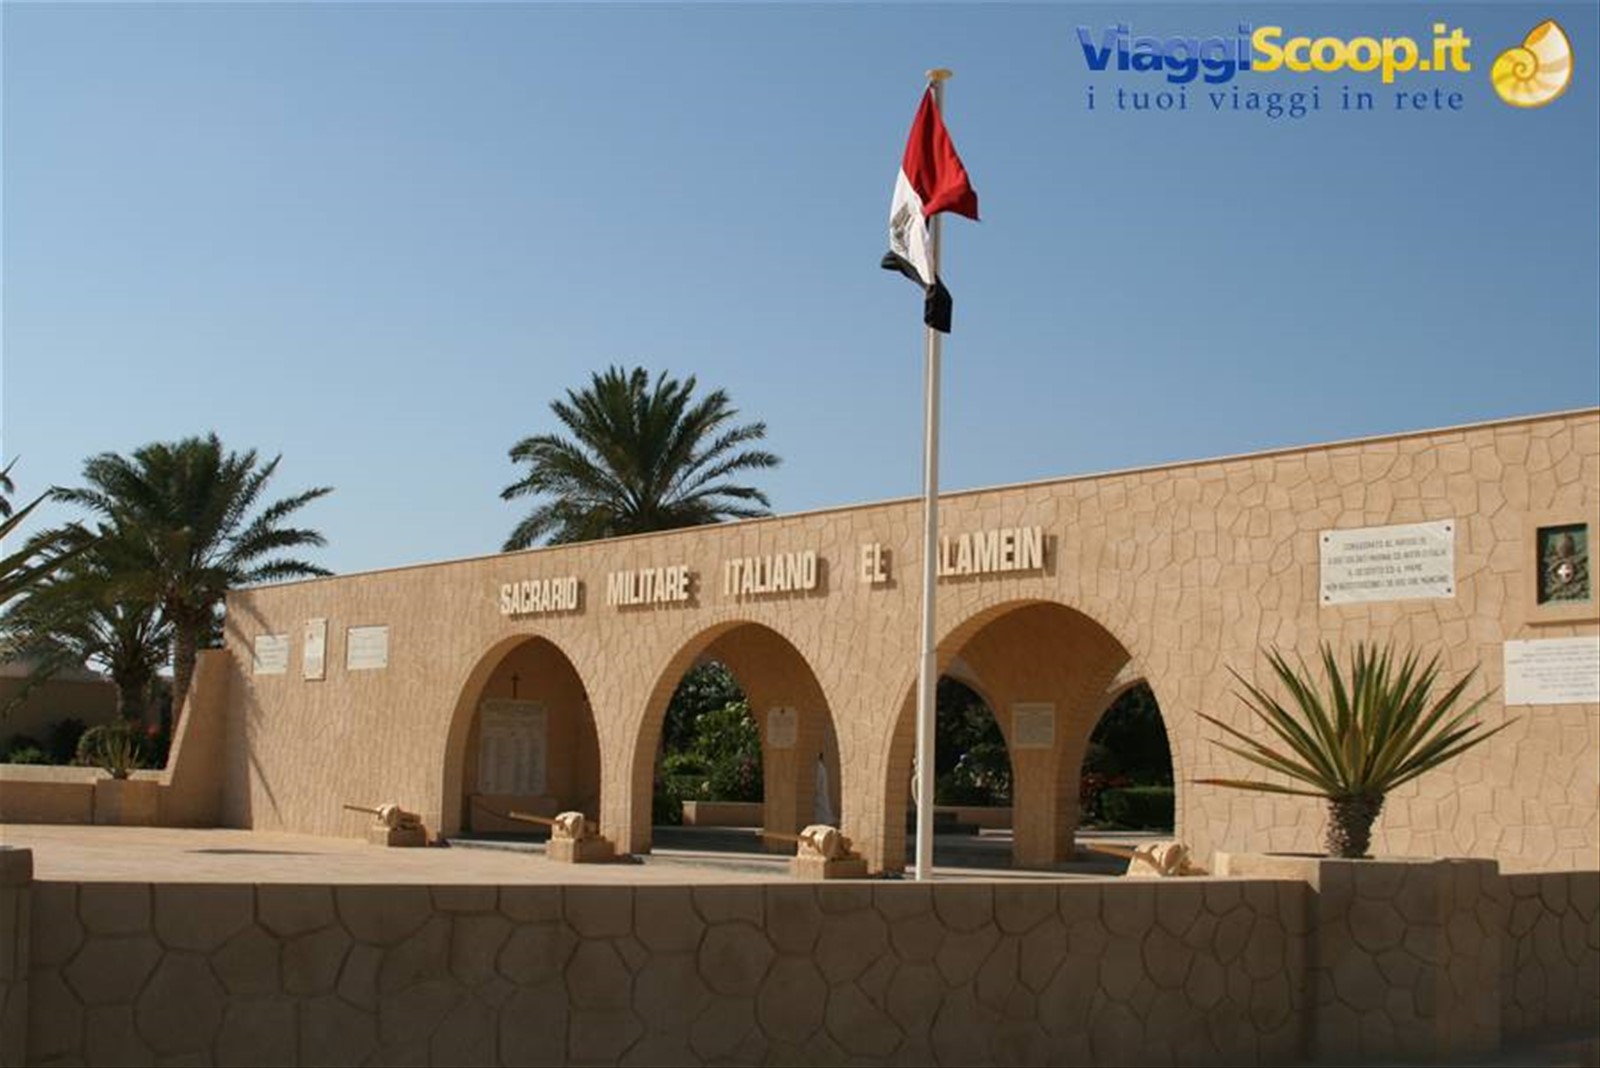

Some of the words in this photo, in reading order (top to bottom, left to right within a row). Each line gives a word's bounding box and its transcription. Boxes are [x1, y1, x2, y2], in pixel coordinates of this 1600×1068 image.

[500, 576, 578, 615] SACRARIO
[607, 565, 689, 606] MILITARE
[724, 550, 817, 596] ITALIANO
[861, 542, 888, 583] EL
[936, 525, 1042, 577] LAMEIN
